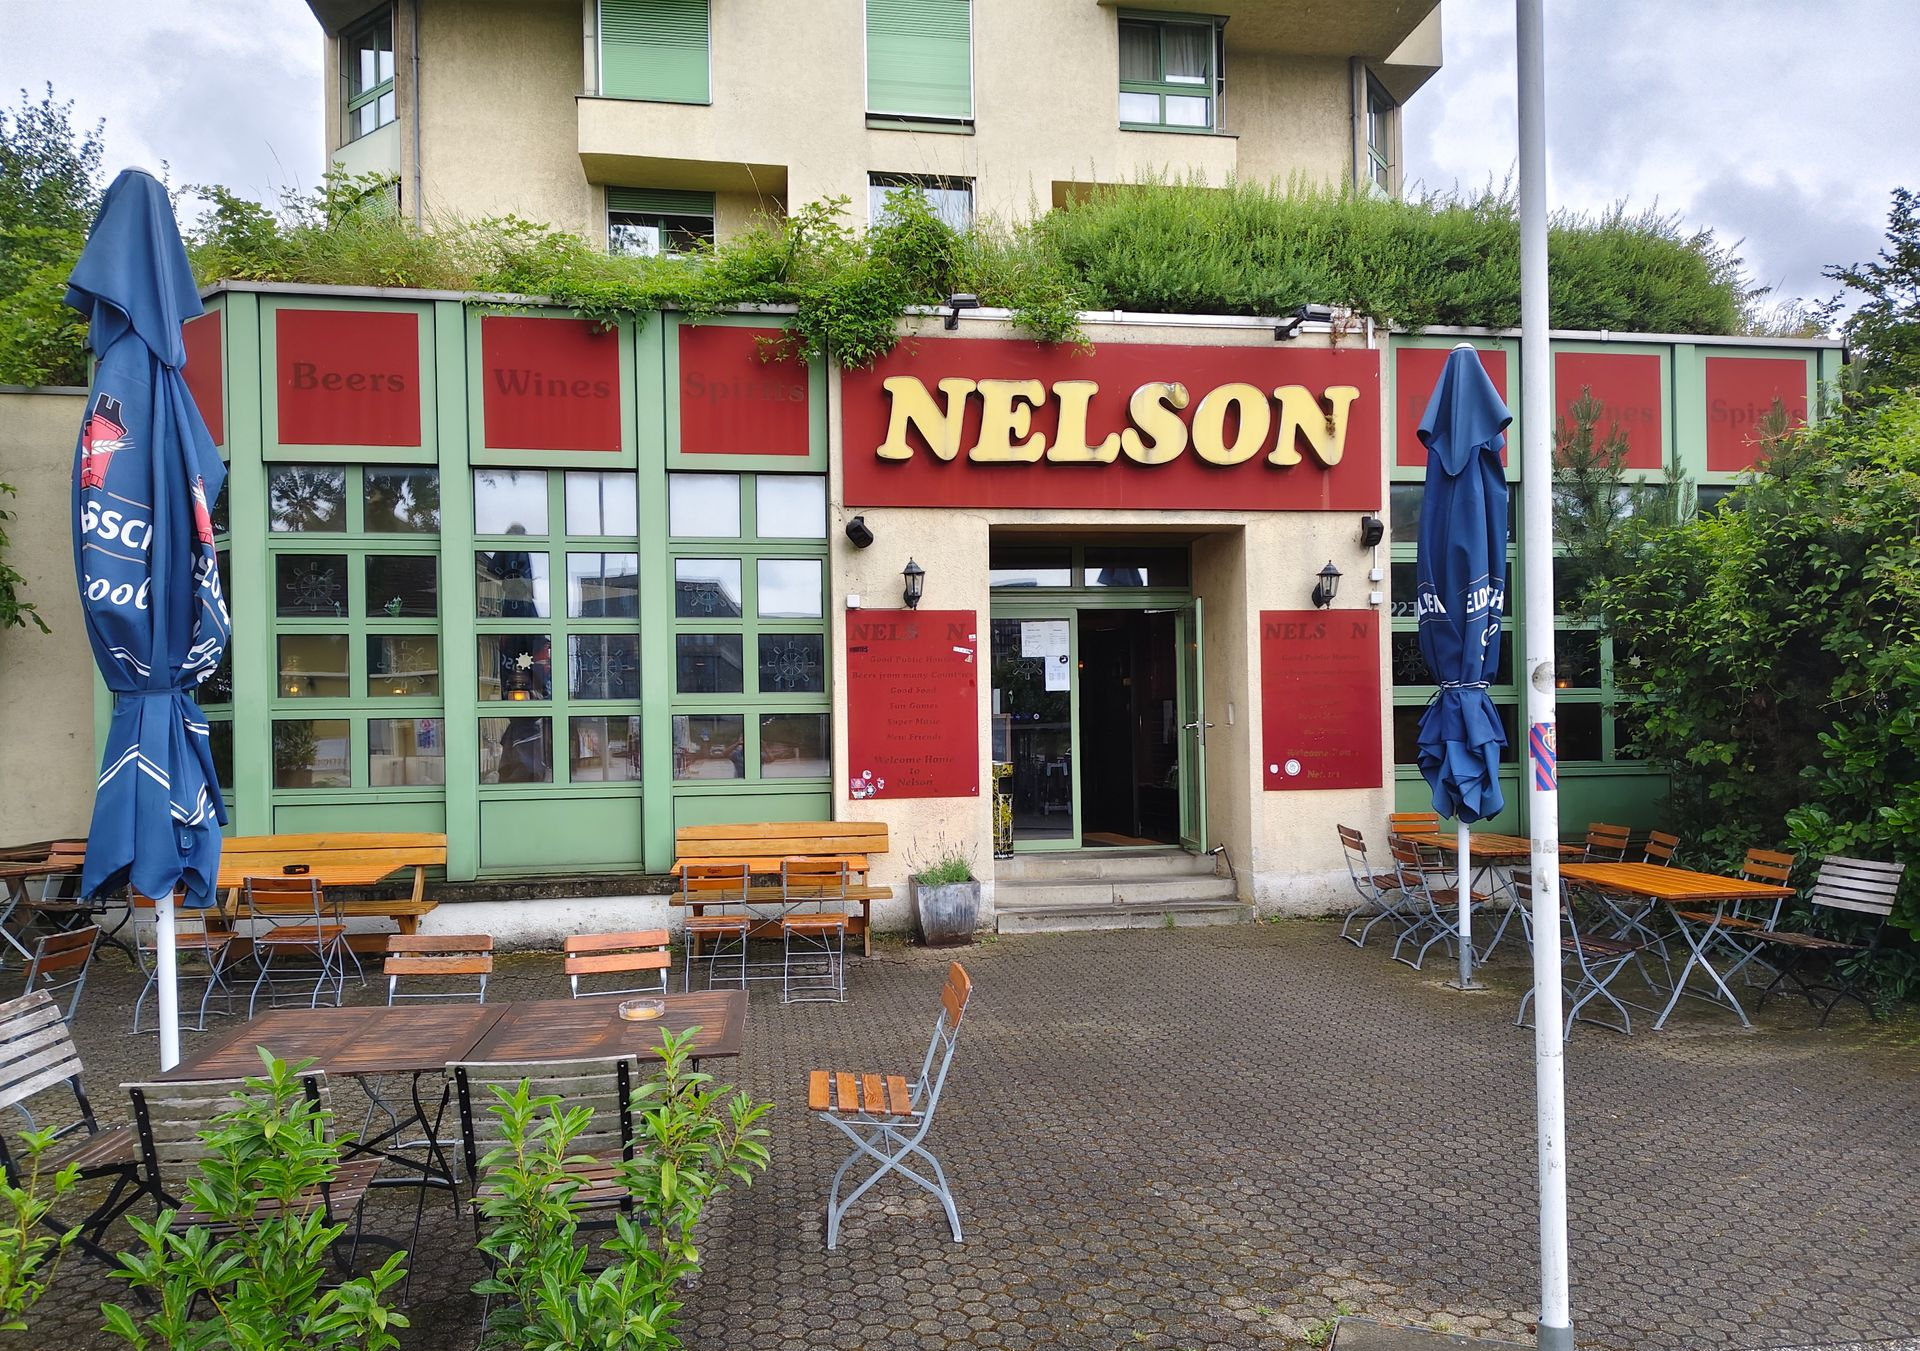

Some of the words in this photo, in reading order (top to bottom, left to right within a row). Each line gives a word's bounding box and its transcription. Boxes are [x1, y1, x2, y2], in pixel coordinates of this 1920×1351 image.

[292, 362, 406, 393] Beers
[493, 368, 611, 400] Wines
[685, 372, 805, 406] Spirits
[875, 375, 1361, 467] NELSON
